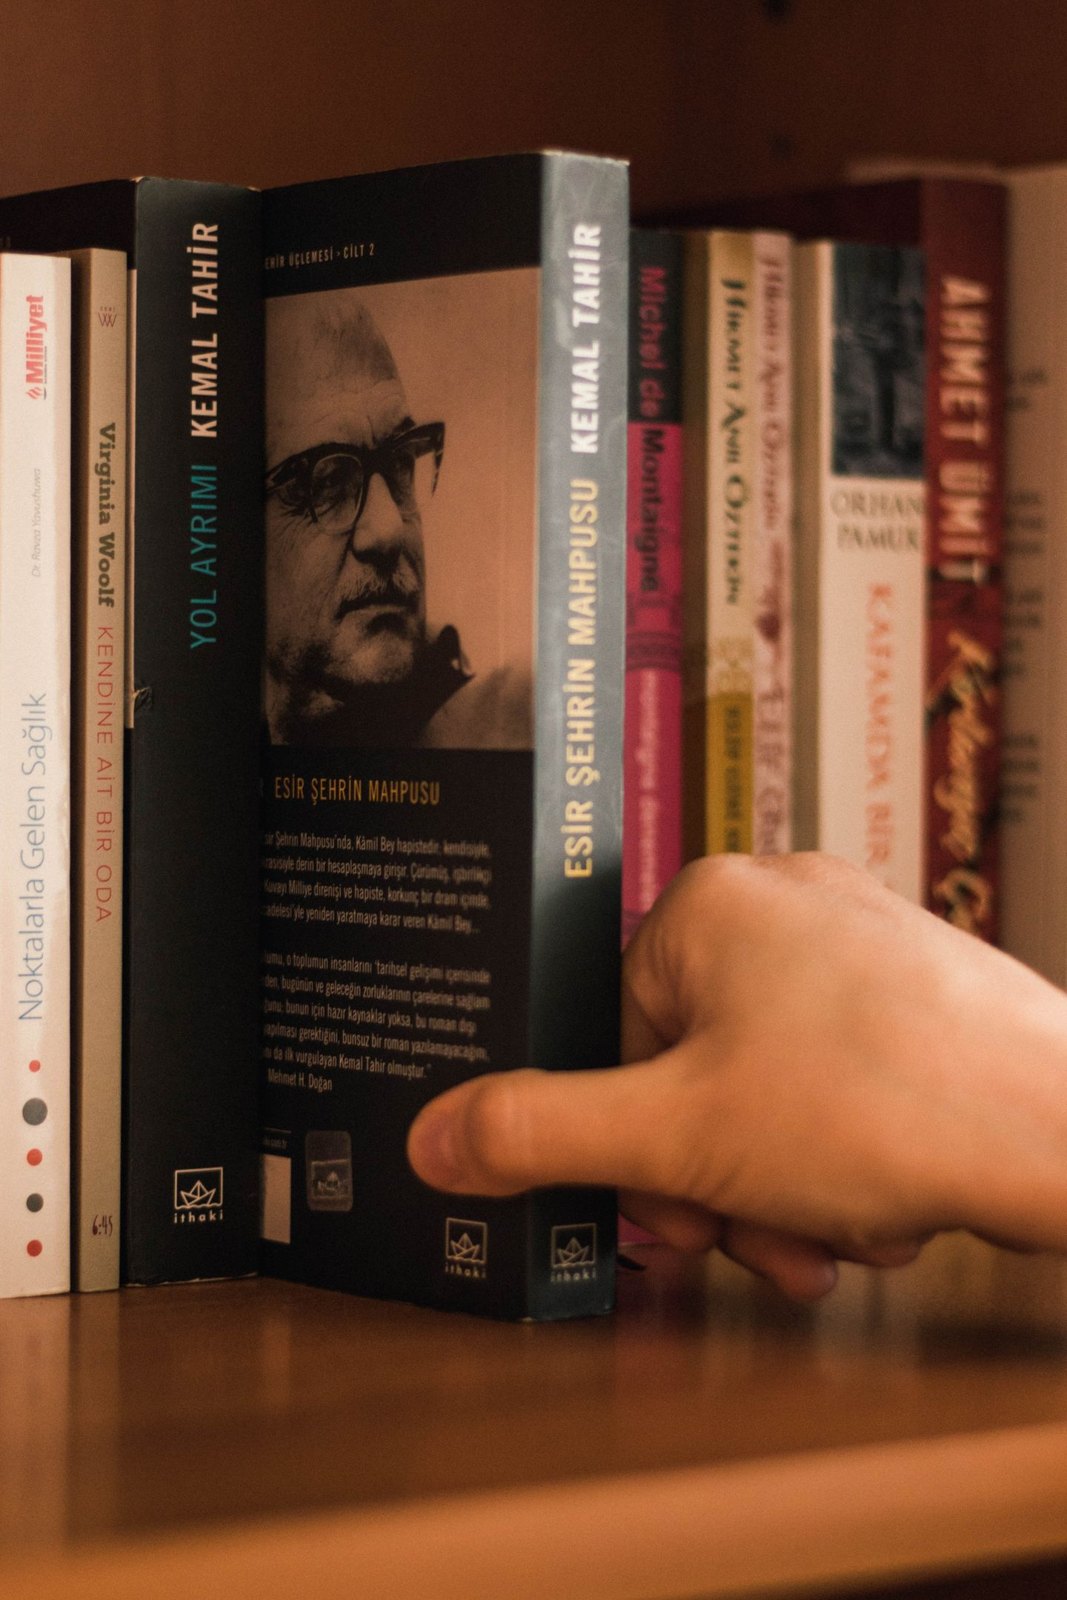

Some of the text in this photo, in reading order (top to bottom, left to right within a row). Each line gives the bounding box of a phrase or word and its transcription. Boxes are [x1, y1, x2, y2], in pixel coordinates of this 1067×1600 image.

[369, 242, 375, 256] 2
[25, 295, 48, 384] Milliyet
[186, 223, 219, 649] YOL AYRIMI KEMAL TAHİR
[634, 266, 666, 593] Michel de Montaigne
[938, 276, 994, 583] AHMET ÜMİT
[560, 223, 601, 878] ESİR ŞEHRİN MAHPUSU KEMAL TAHİR
[95, 422, 116, 923] Virginia Woolf KENDİNE AİT BİR ODA
[274, 773, 305, 799] ESİR
[311, 775, 362, 806] ŞEHRİN
[368, 779, 440, 805] MAHPUSU
[17, 693, 53, 1021] Noktalarla Gelen Sağlık
[380, 836, 395, 855] Bey
[296, 857, 314, 872] derin
[315, 857, 326, 872] bir
[327, 858, 382, 879] hesaplaşmaya
[313, 882, 342, 901] direnişi
[343, 887, 353, 899] ve
[354, 884, 386, 903] hapiste,
[305, 906, 335, 922] yeniden
[336, 909, 378, 927] yaratmaya
[379, 910, 401, 926] karar
[402, 915, 426, 929] veren
[286, 954, 292, 965] o
[293, 952, 329, 970] toplumun
[330, 956, 372, 974] insanlarını
[281, 976, 314, 993] bugünün
[315, 980, 324, 993] ve
[325, 980, 361, 999] geleceğin
[285, 999, 310, 1015] bunun
[311, 1002, 325, 1020] için
[327, 1004, 346, 1020] hazır
[347, 1006, 386, 1024] kaynaklar
[387, 1011, 413, 1028] yoksa,
[415, 1014, 427, 1028] bu
[299, 1026, 340, 1045] gerektiğini,
[342, 1029, 370, 1047] bunsuz
[371, 1033, 382, 1048] bir
[384, 1038, 410, 1051] roman
[273, 1047, 283, 1060] da
[295, 1050, 337, 1068] vurgulayan
[339, 1053, 364, 1070] Kemal
[365, 1056, 385, 1073] Tahir
[267, 1067, 297, 1086] Mehmet
[308, 1073, 333, 1093] Doğan
[92, 1214, 113, 1237] 6:45
[174, 1209, 223, 1224] ithaki
